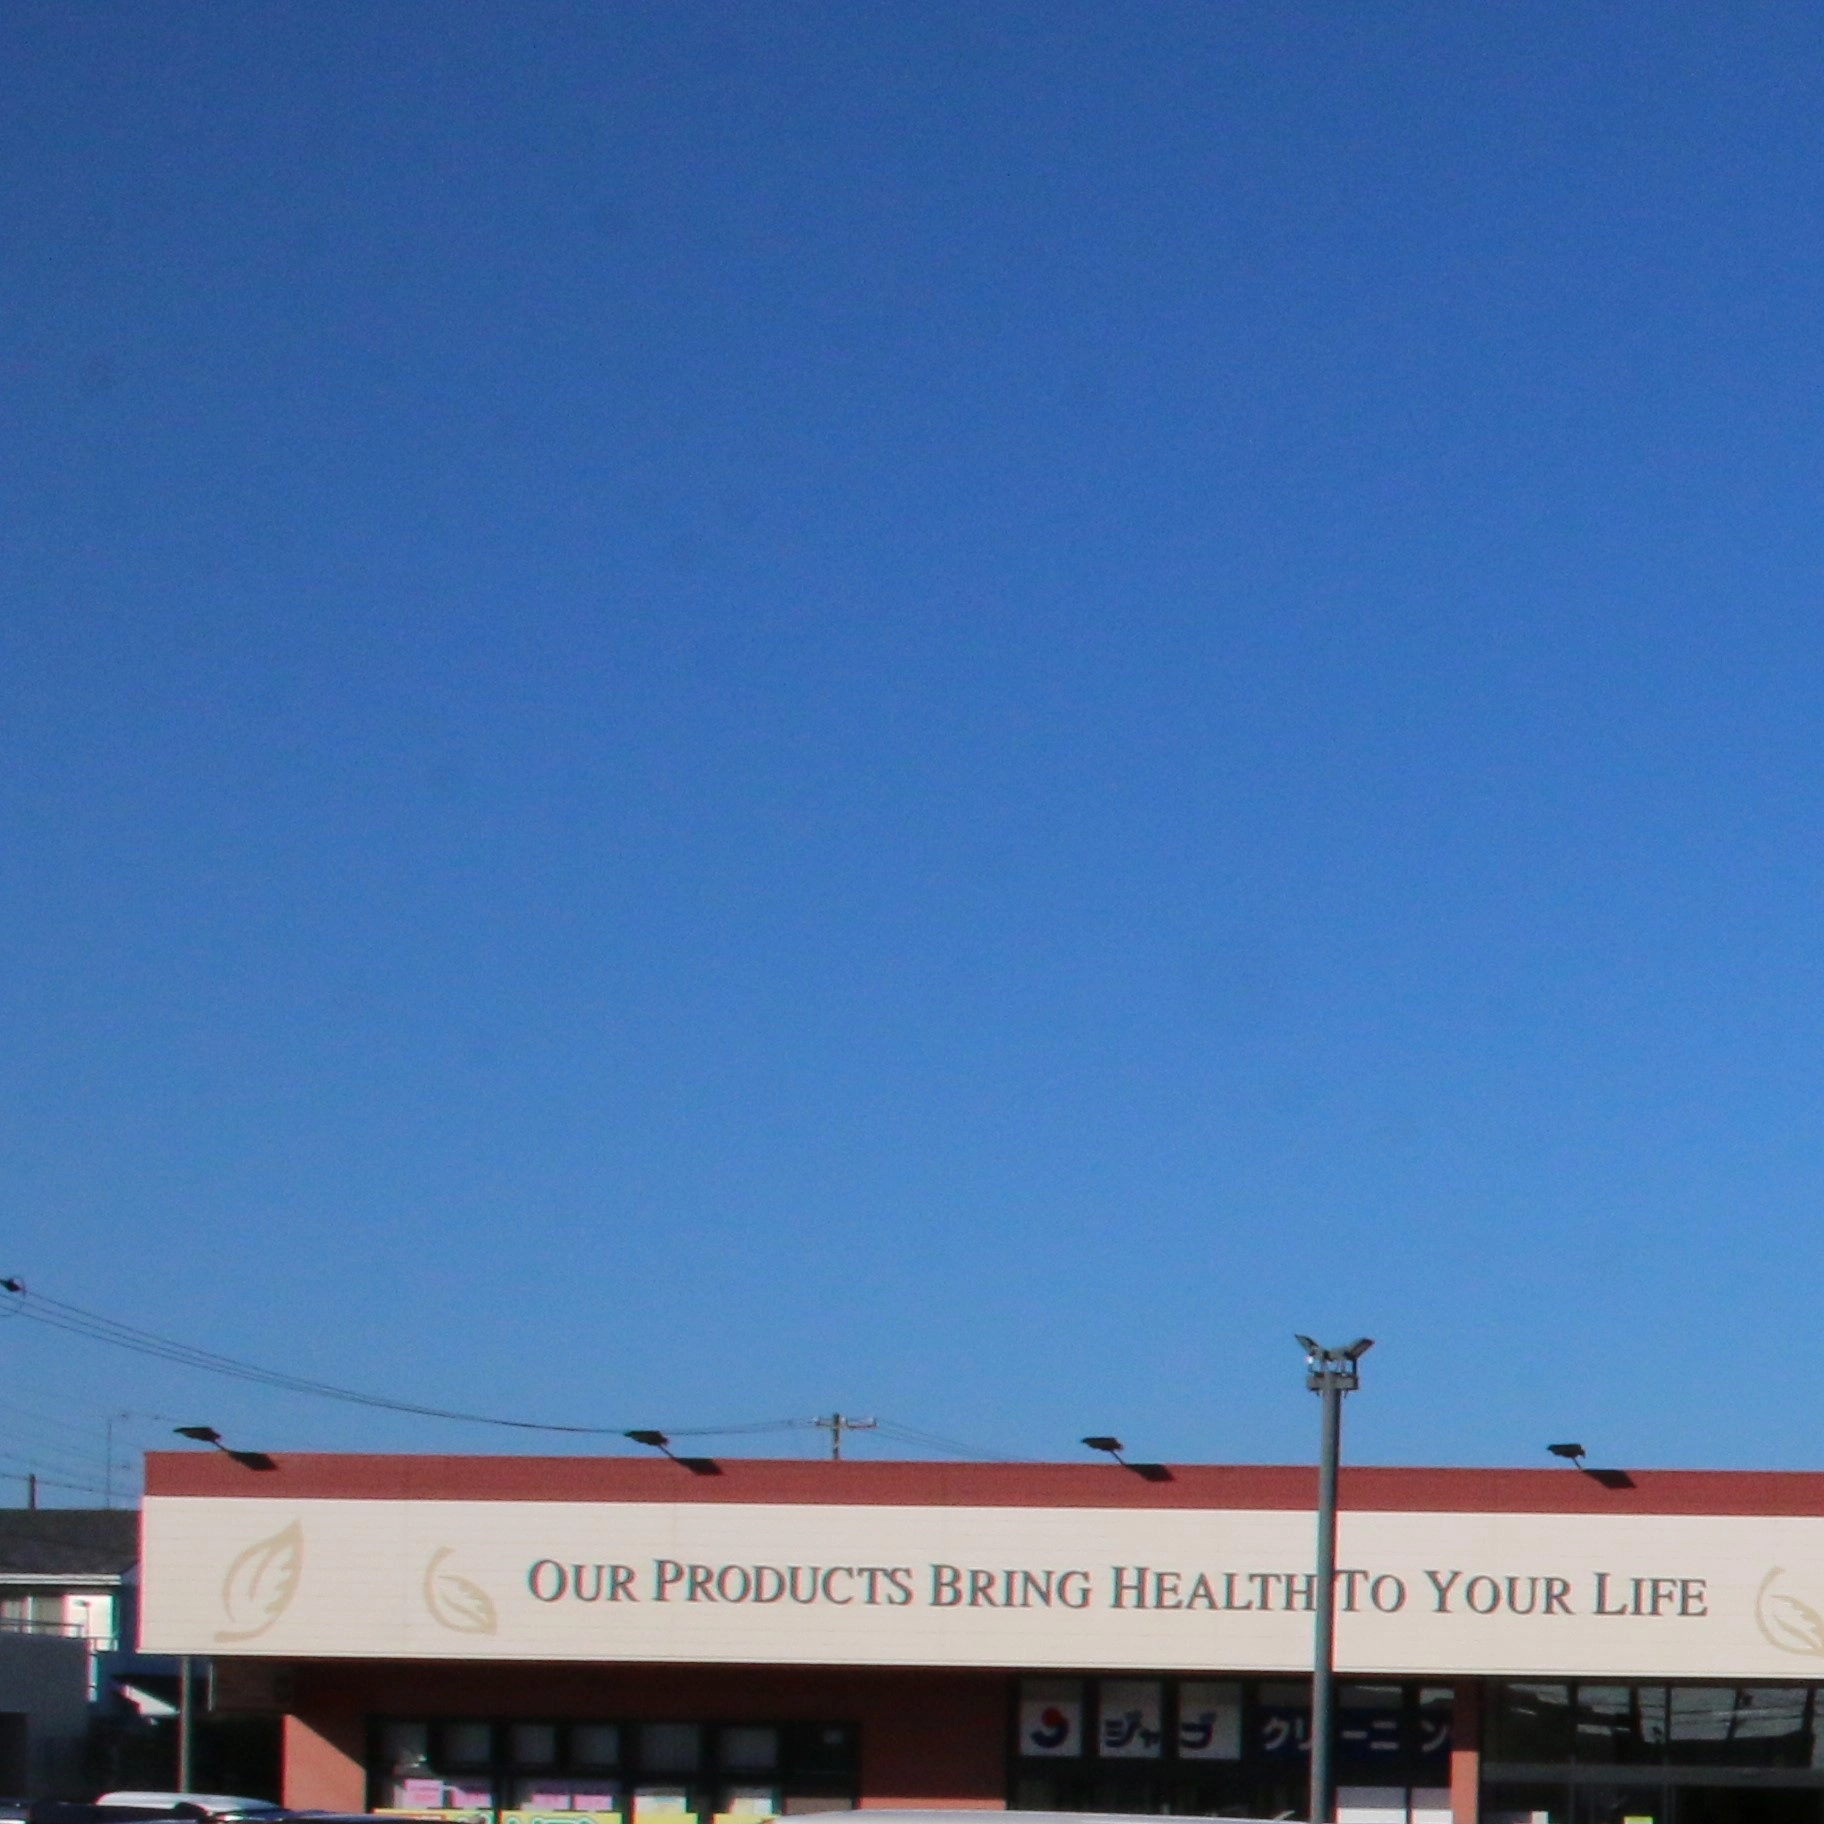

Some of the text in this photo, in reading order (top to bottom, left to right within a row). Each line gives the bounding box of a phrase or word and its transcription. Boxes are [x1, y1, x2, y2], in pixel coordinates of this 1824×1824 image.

[528, 1559, 1709, 1618] OUR PRODUCTS BRING HEALTH TO YOUR LIFE
